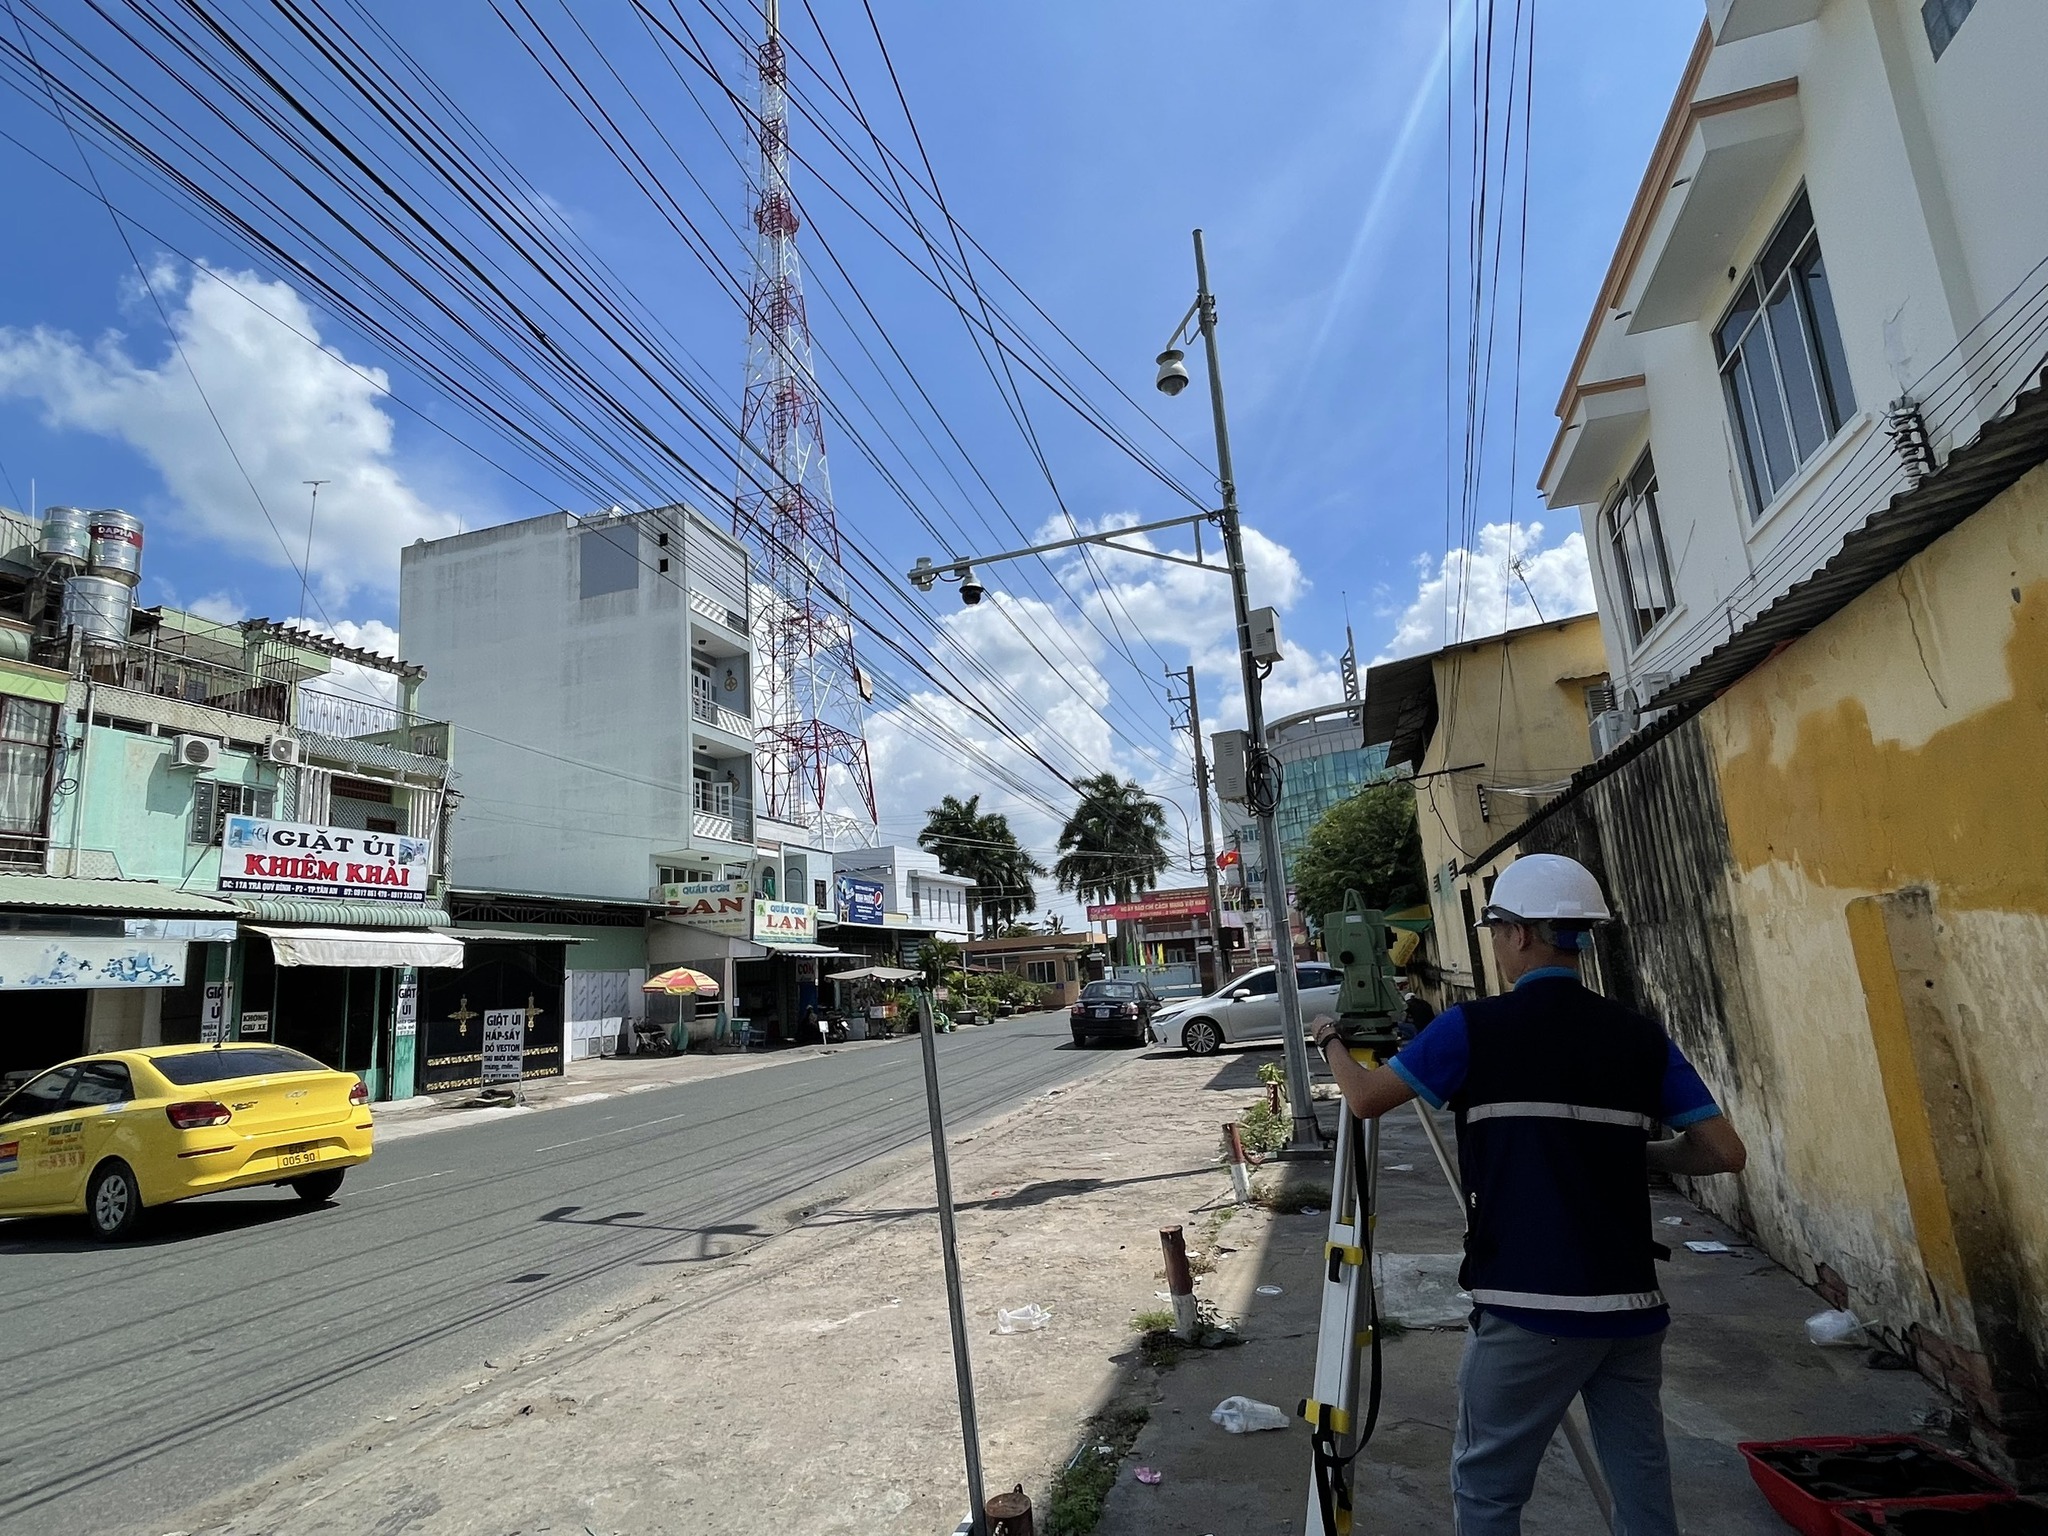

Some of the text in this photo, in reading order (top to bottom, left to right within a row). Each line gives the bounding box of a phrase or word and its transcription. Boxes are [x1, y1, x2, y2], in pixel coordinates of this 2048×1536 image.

[272, 829, 395, 857] GIẶT ỦI
[244, 853, 410, 886] KHIÊM KHẢI
[683, 884, 708, 894] QUÁN
[667, 897, 745, 917] LAN
[766, 914, 807, 930] LAN
[487, 1012, 521, 1028] GIẶT ỦI
[496, 1044, 520, 1052] VESTON
